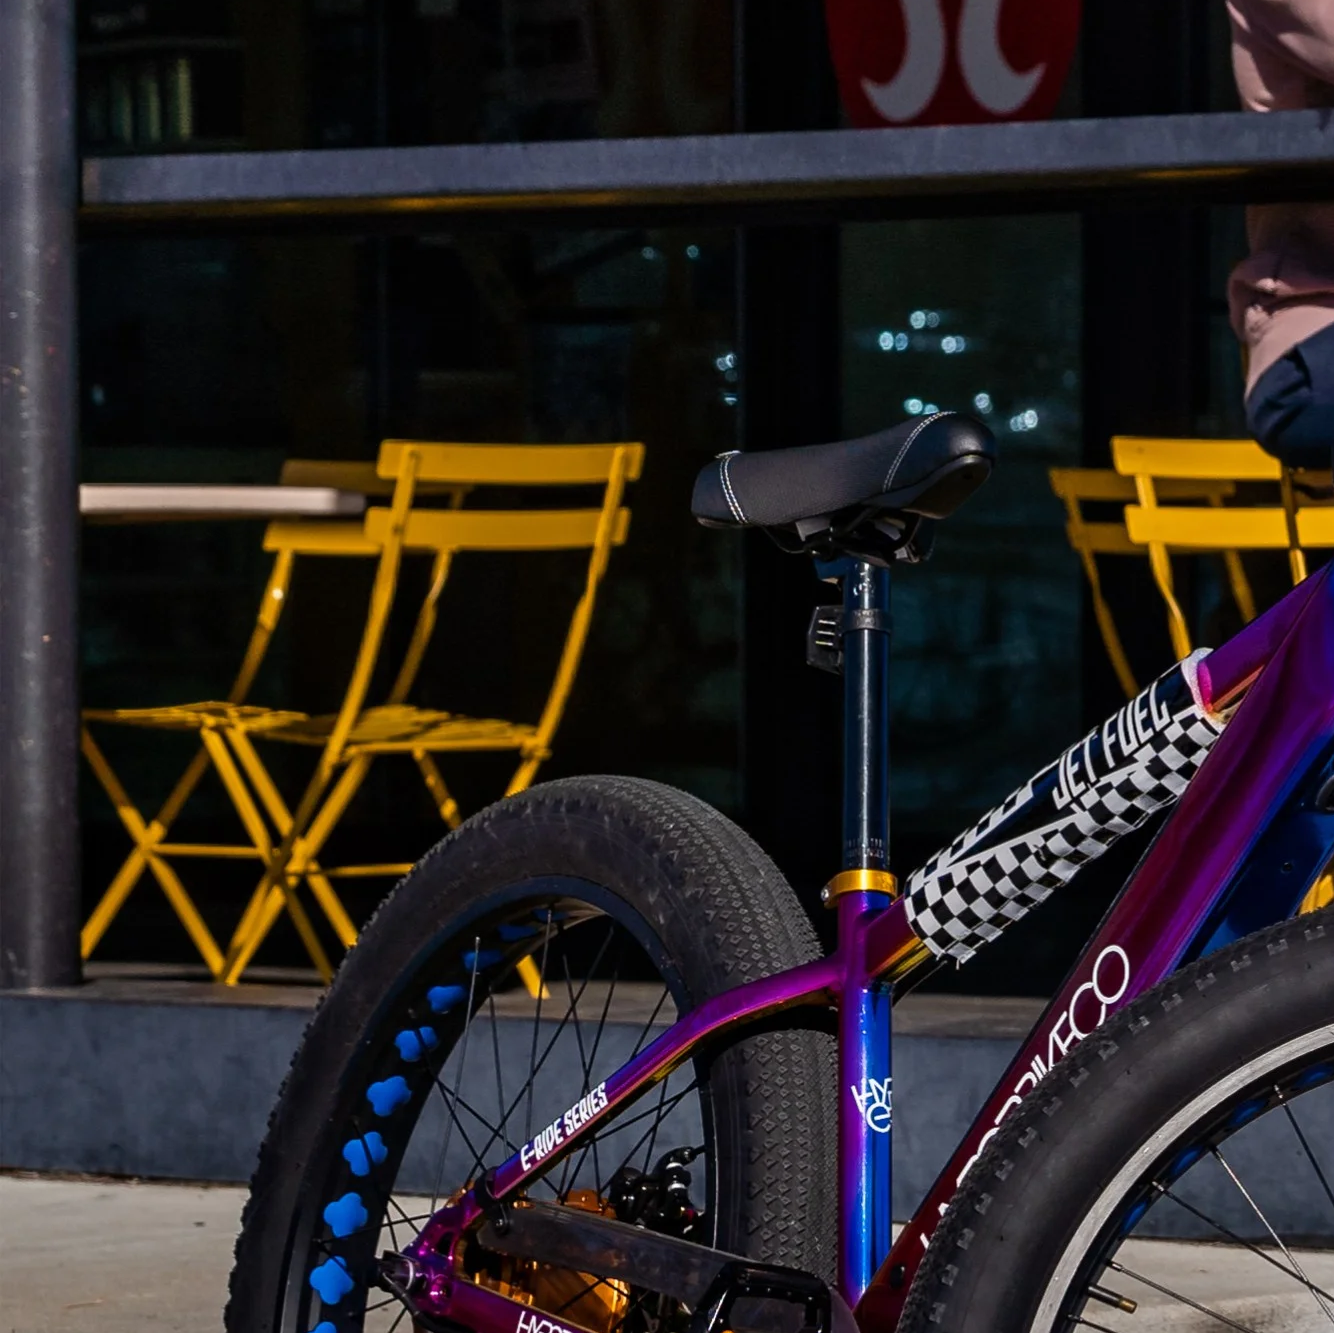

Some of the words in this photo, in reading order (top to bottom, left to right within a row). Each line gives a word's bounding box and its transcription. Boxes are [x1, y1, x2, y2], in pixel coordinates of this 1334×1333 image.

[1052, 725, 1099, 810] JET
[1103, 681, 1171, 768] FUEL
[520, 1118, 564, 1172] E-RIDE
[564, 1082, 608, 1136] SERIES
